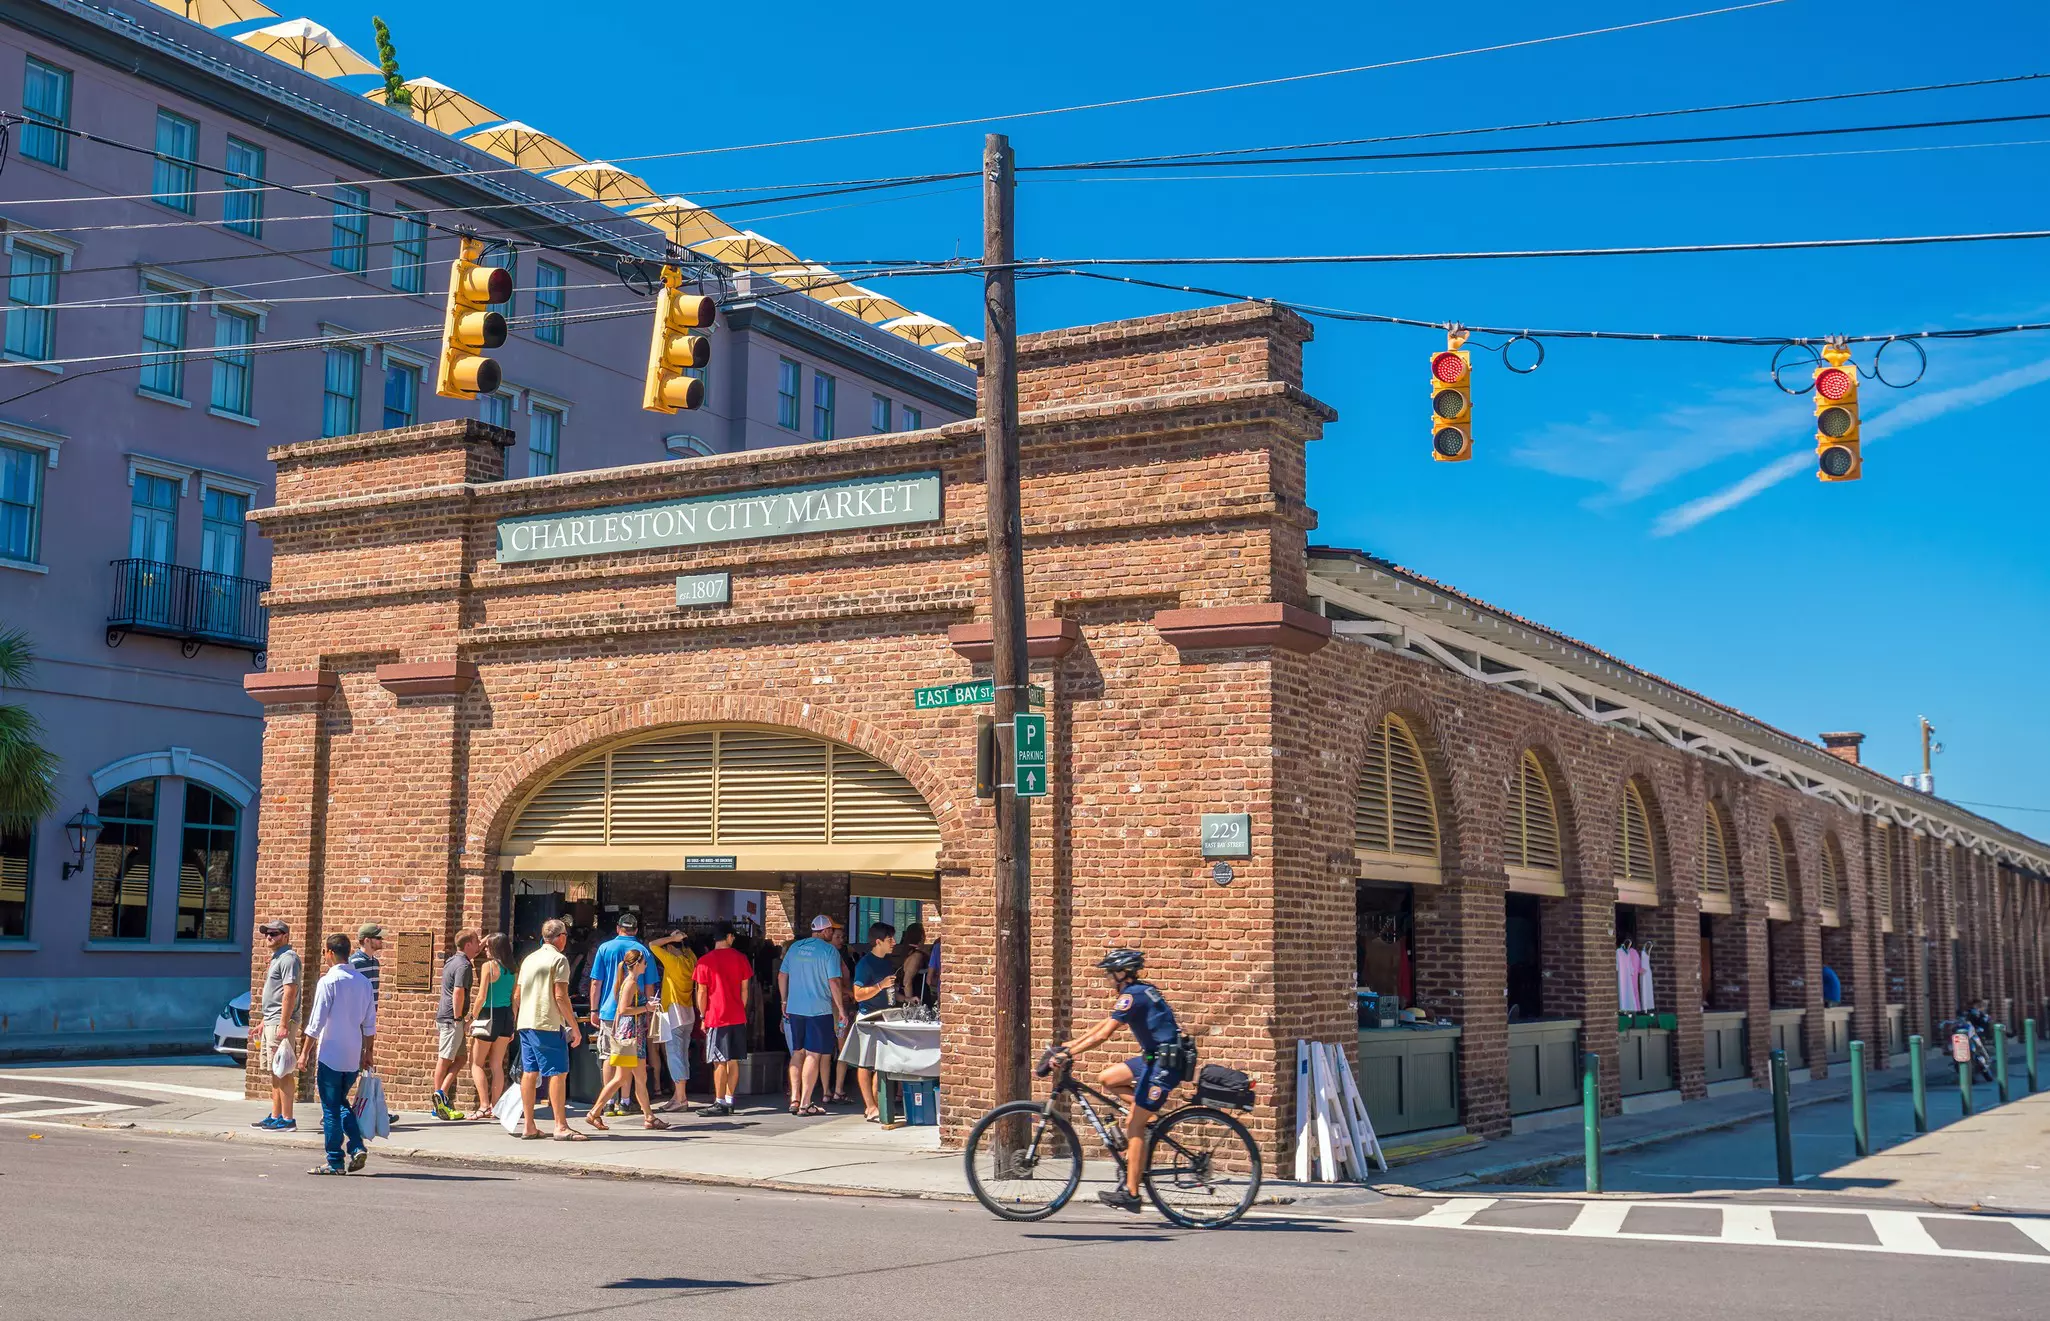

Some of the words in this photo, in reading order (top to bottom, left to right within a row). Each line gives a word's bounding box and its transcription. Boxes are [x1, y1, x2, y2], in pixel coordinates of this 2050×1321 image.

[511, 507, 699, 552] CHARLESTON
[707, 498, 778, 532] CITY
[785, 483, 920, 525] MARKET
[680, 591, 691, 600] est.
[691, 580, 724, 599] 1807
[918, 689, 949, 707] EAST
[955, 685, 979, 703] BAY
[980, 688, 991, 698] ST
[1027, 724, 1037, 745] P
[1018, 750, 1044, 760] PARKING
[1210, 823, 1240, 839] 229
